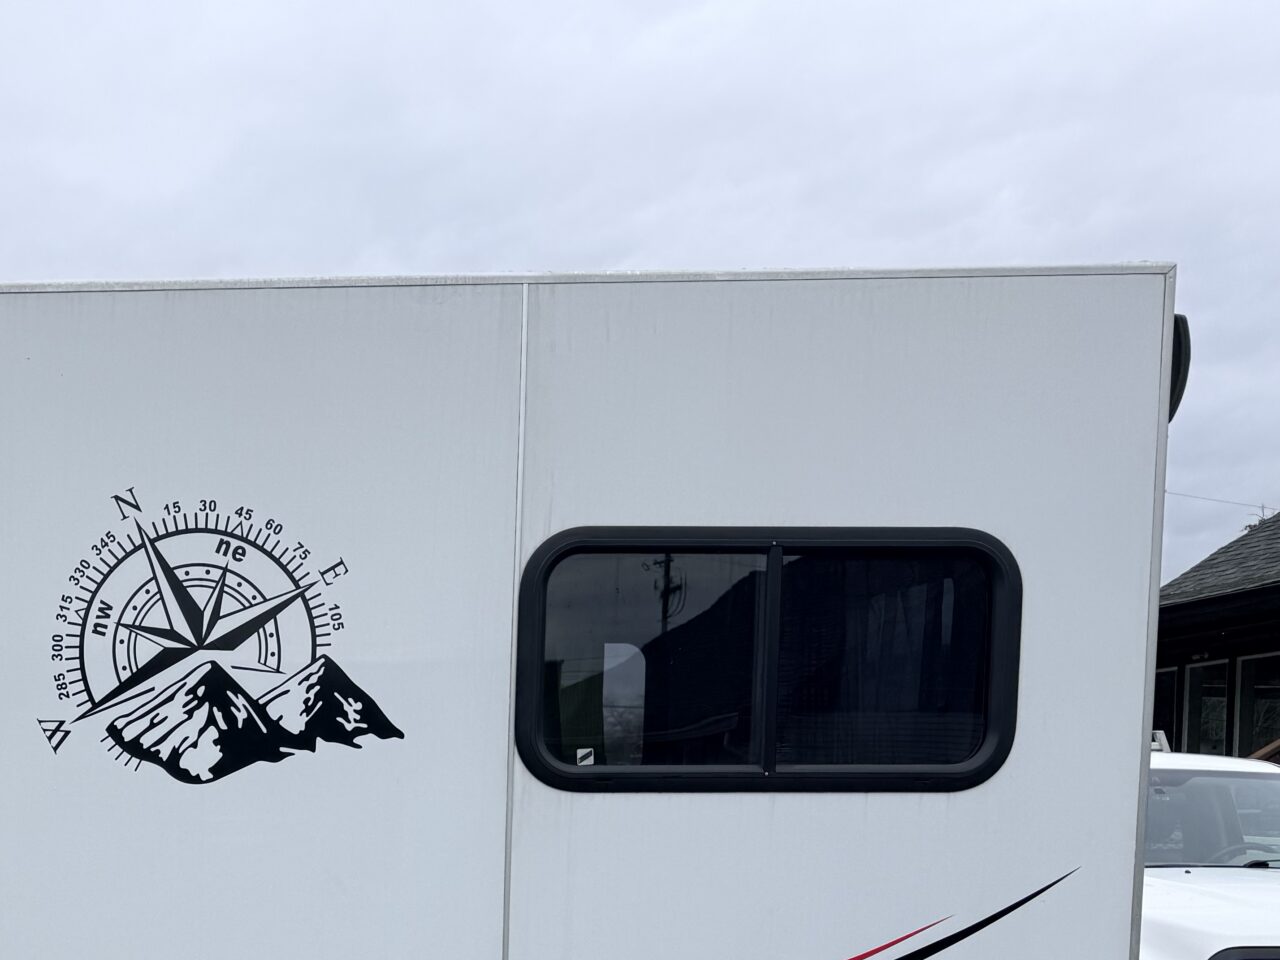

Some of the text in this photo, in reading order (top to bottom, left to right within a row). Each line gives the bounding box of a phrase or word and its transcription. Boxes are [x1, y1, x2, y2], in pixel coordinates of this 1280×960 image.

[111, 487, 142, 520] N
[163, 500, 182, 516] 15
[198, 499, 217, 512] 30
[234, 506, 254, 521] 45
[264, 518, 283, 536] 60
[91, 530, 117, 557] 345
[214, 537, 247, 563] ne
[292, 541, 311, 561] 75
[68, 559, 91, 586] 330
[318, 557, 349, 587] E
[55, 594, 73, 623] 315
[91, 599, 114, 637] nw
[328, 603, 345, 631] 105
[51, 634, 64, 662] 300
[53, 672, 71, 701] 285
